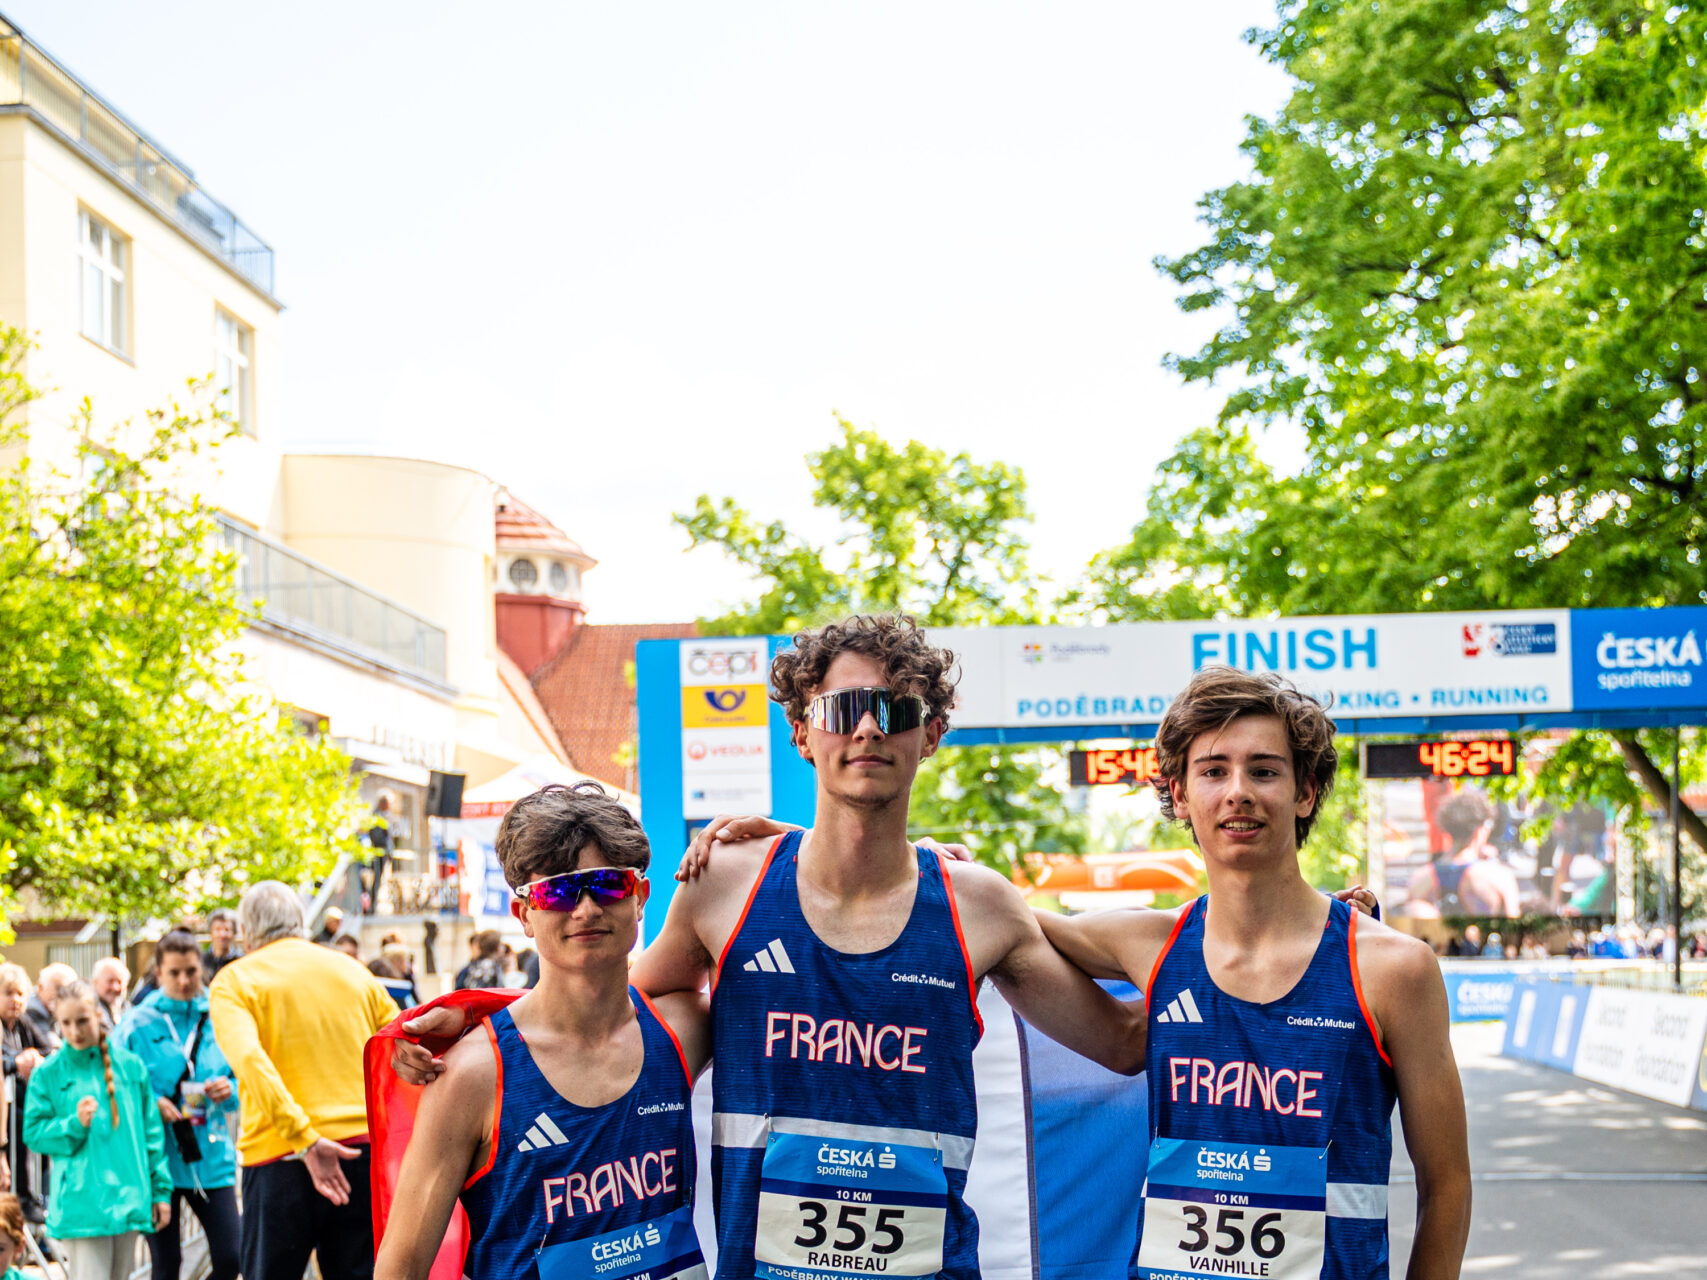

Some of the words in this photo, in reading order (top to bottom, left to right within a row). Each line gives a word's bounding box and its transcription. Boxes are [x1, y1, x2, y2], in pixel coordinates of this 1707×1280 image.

[1193, 628, 1376, 673] FINISH
[1597, 629, 1701, 669] ČESKÁ
[1598, 669, 1692, 691] spořitelna
[1017, 691, 1174, 718] PODĚBRAD
[1308, 689, 1399, 712] LKING
[1431, 685, 1549, 707] RUNNING
[1419, 741, 1513, 777] 46:24
[891, 971, 919, 984] Crédit
[928, 977, 956, 990] Mutuel
[1287, 1015, 1314, 1027] Crédit
[1324, 1018, 1356, 1030] Mutuel
[765, 1011, 928, 1073] FRANCE
[1169, 1056, 1323, 1118] FRANCE
[637, 1104, 660, 1116] Crédit
[817, 1143, 875, 1169] ČESKÁ
[1197, 1146, 1250, 1171] ČESKÁ
[816, 1165, 868, 1179] spořitelna
[1196, 1169, 1244, 1181] spořitelna
[542, 1148, 677, 1224] FRANCE
[836, 1190, 850, 1200] 10
[852, 1191, 872, 1202] KM
[1214, 1193, 1227, 1204] 10
[1230, 1195, 1249, 1205] KM
[794, 1201, 905, 1255] 355
[1178, 1205, 1286, 1259] 356
[591, 1229, 645, 1261] ČESKÁ
[594, 1252, 642, 1274] spořitelna
[807, 1251, 888, 1272] RABREAU
[1189, 1256, 1270, 1277] VANHILLE
